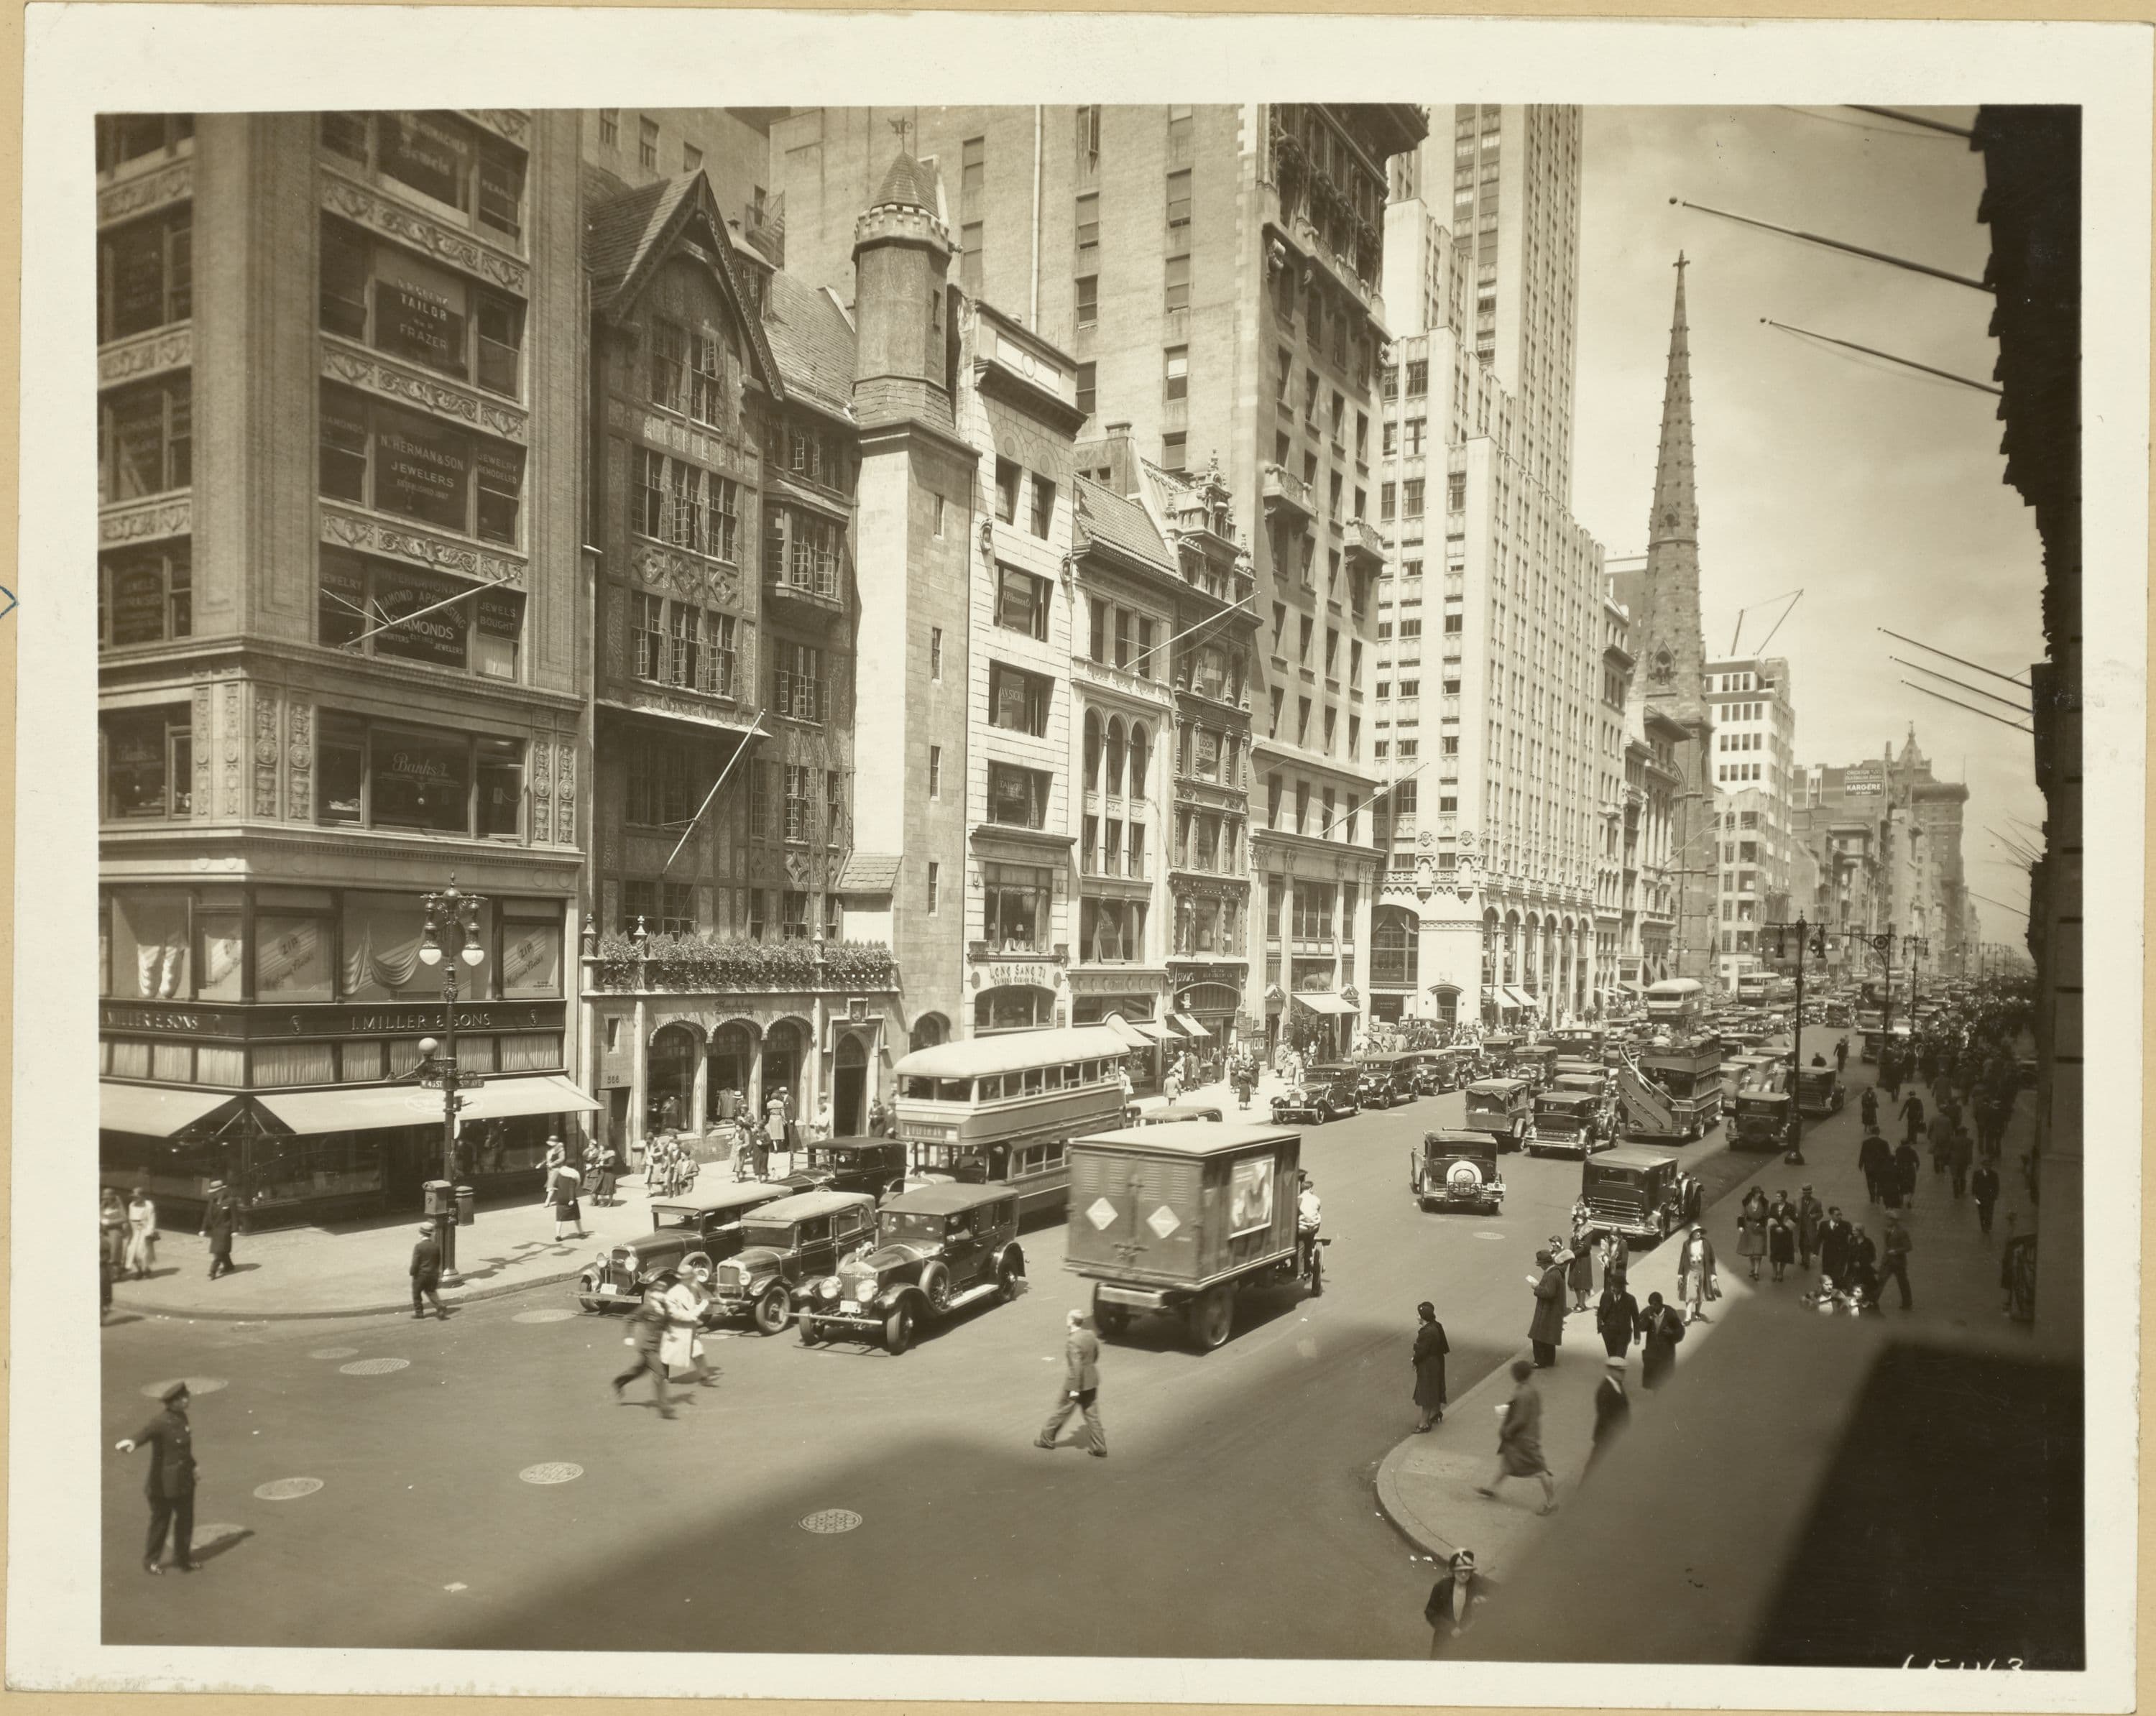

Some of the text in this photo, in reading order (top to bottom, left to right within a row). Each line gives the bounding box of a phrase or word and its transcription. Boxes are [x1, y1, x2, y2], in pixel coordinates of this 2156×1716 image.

[400, 292, 447, 320] TAILOR
[400, 323, 448, 351] FRAZER
[391, 460, 455, 488] JEWELERS
[479, 601, 516, 618] JEWELS
[479, 615, 515, 632] BOUGHT
[1015, 963, 1035, 977] SANG
[167, 1014, 198, 1030] SONS
[363, 1015, 427, 1030] MILLER
[436, 1014, 444, 1028] &
[453, 1013, 491, 1027] SONS
